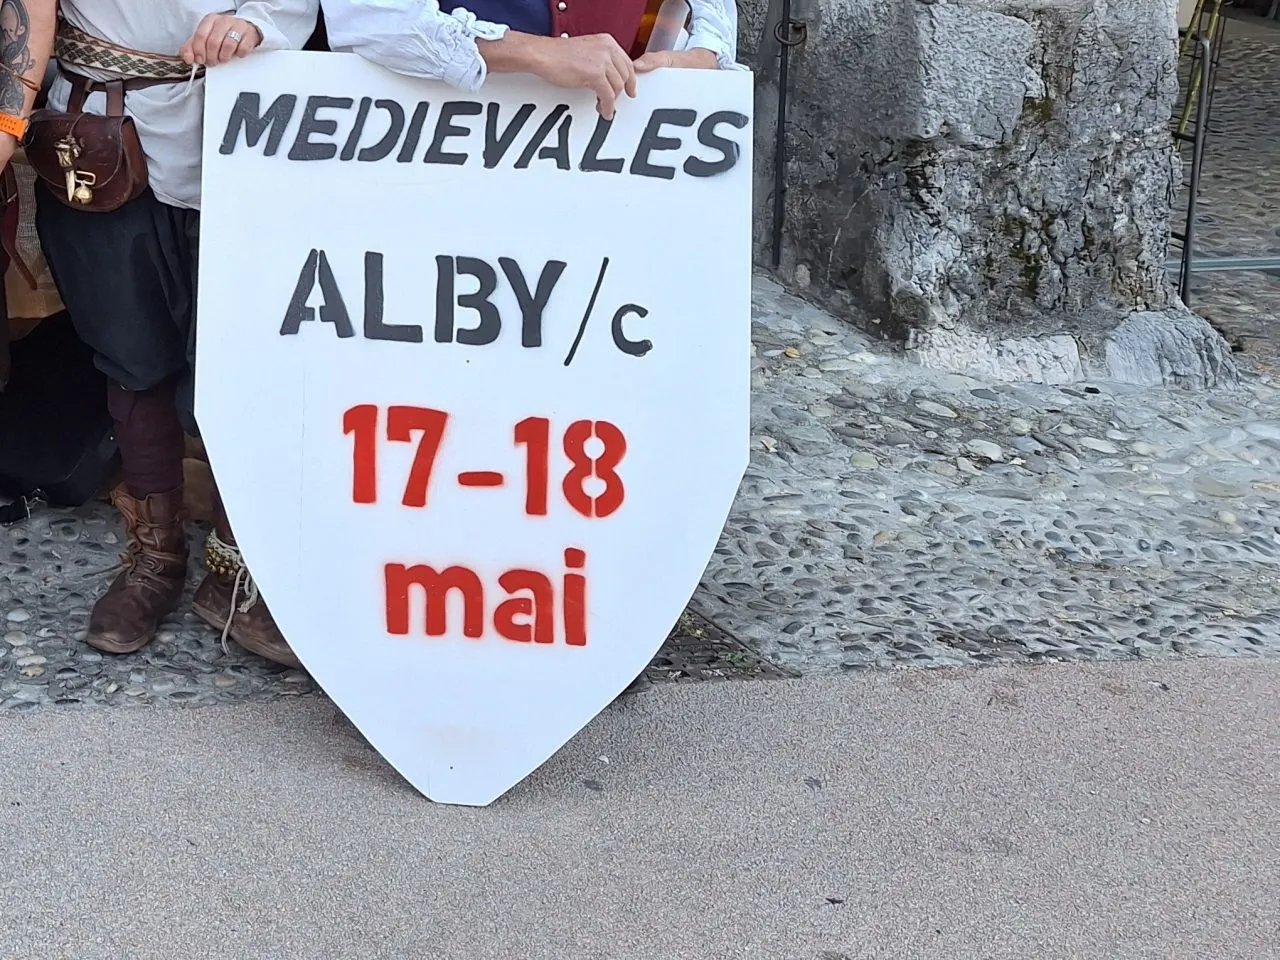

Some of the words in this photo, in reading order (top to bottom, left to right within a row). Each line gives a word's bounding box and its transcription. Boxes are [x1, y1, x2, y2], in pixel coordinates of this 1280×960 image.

[219, 91, 749, 180] MEDIEVALES
[342, 403, 628, 519] 17-18
[384, 546, 587, 647] mai
